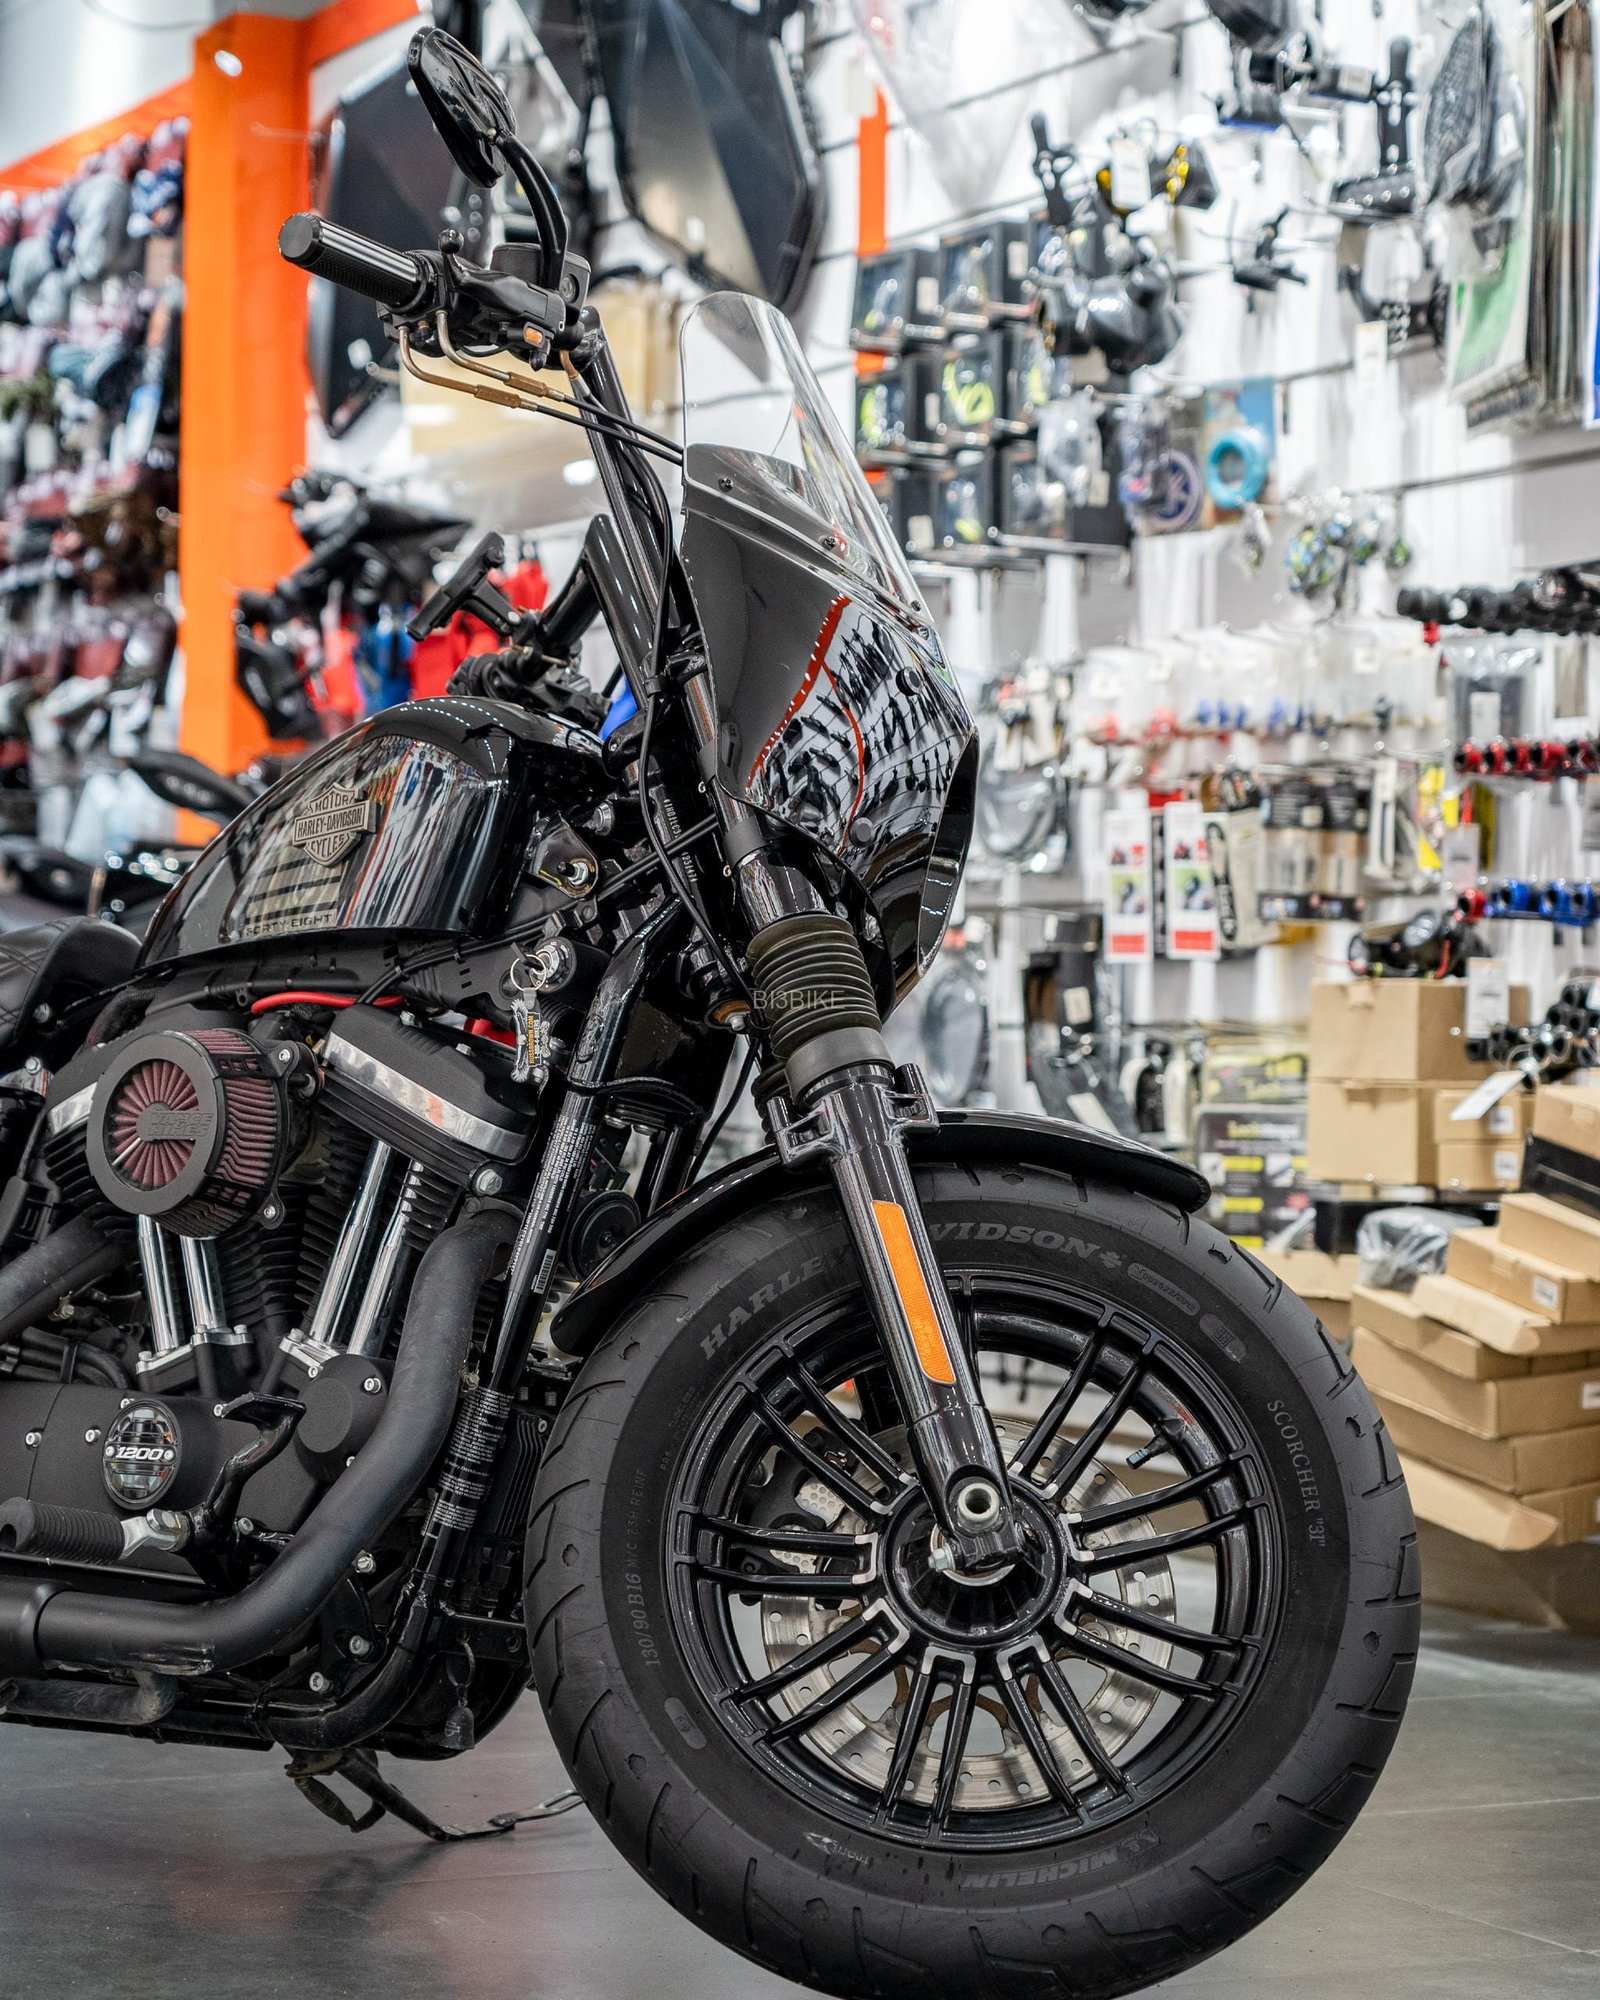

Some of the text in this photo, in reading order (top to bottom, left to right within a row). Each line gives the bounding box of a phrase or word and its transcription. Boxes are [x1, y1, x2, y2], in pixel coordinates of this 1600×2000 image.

[315, 792, 349, 812] MOTOR
[297, 807, 363, 839] HARLEY-DAVIDSON
[311, 833, 346, 858] CYCLES
[245, 913, 332, 936] FORTY-EIGHT
[116, 1446, 164, 1461] 1200
[1267, 1399, 1321, 1513] SCORCHER
[626, 1573, 645, 1607] B16
[631, 1609, 661, 1668] 130/90
[961, 1851, 1119, 1888] MICHELIN
